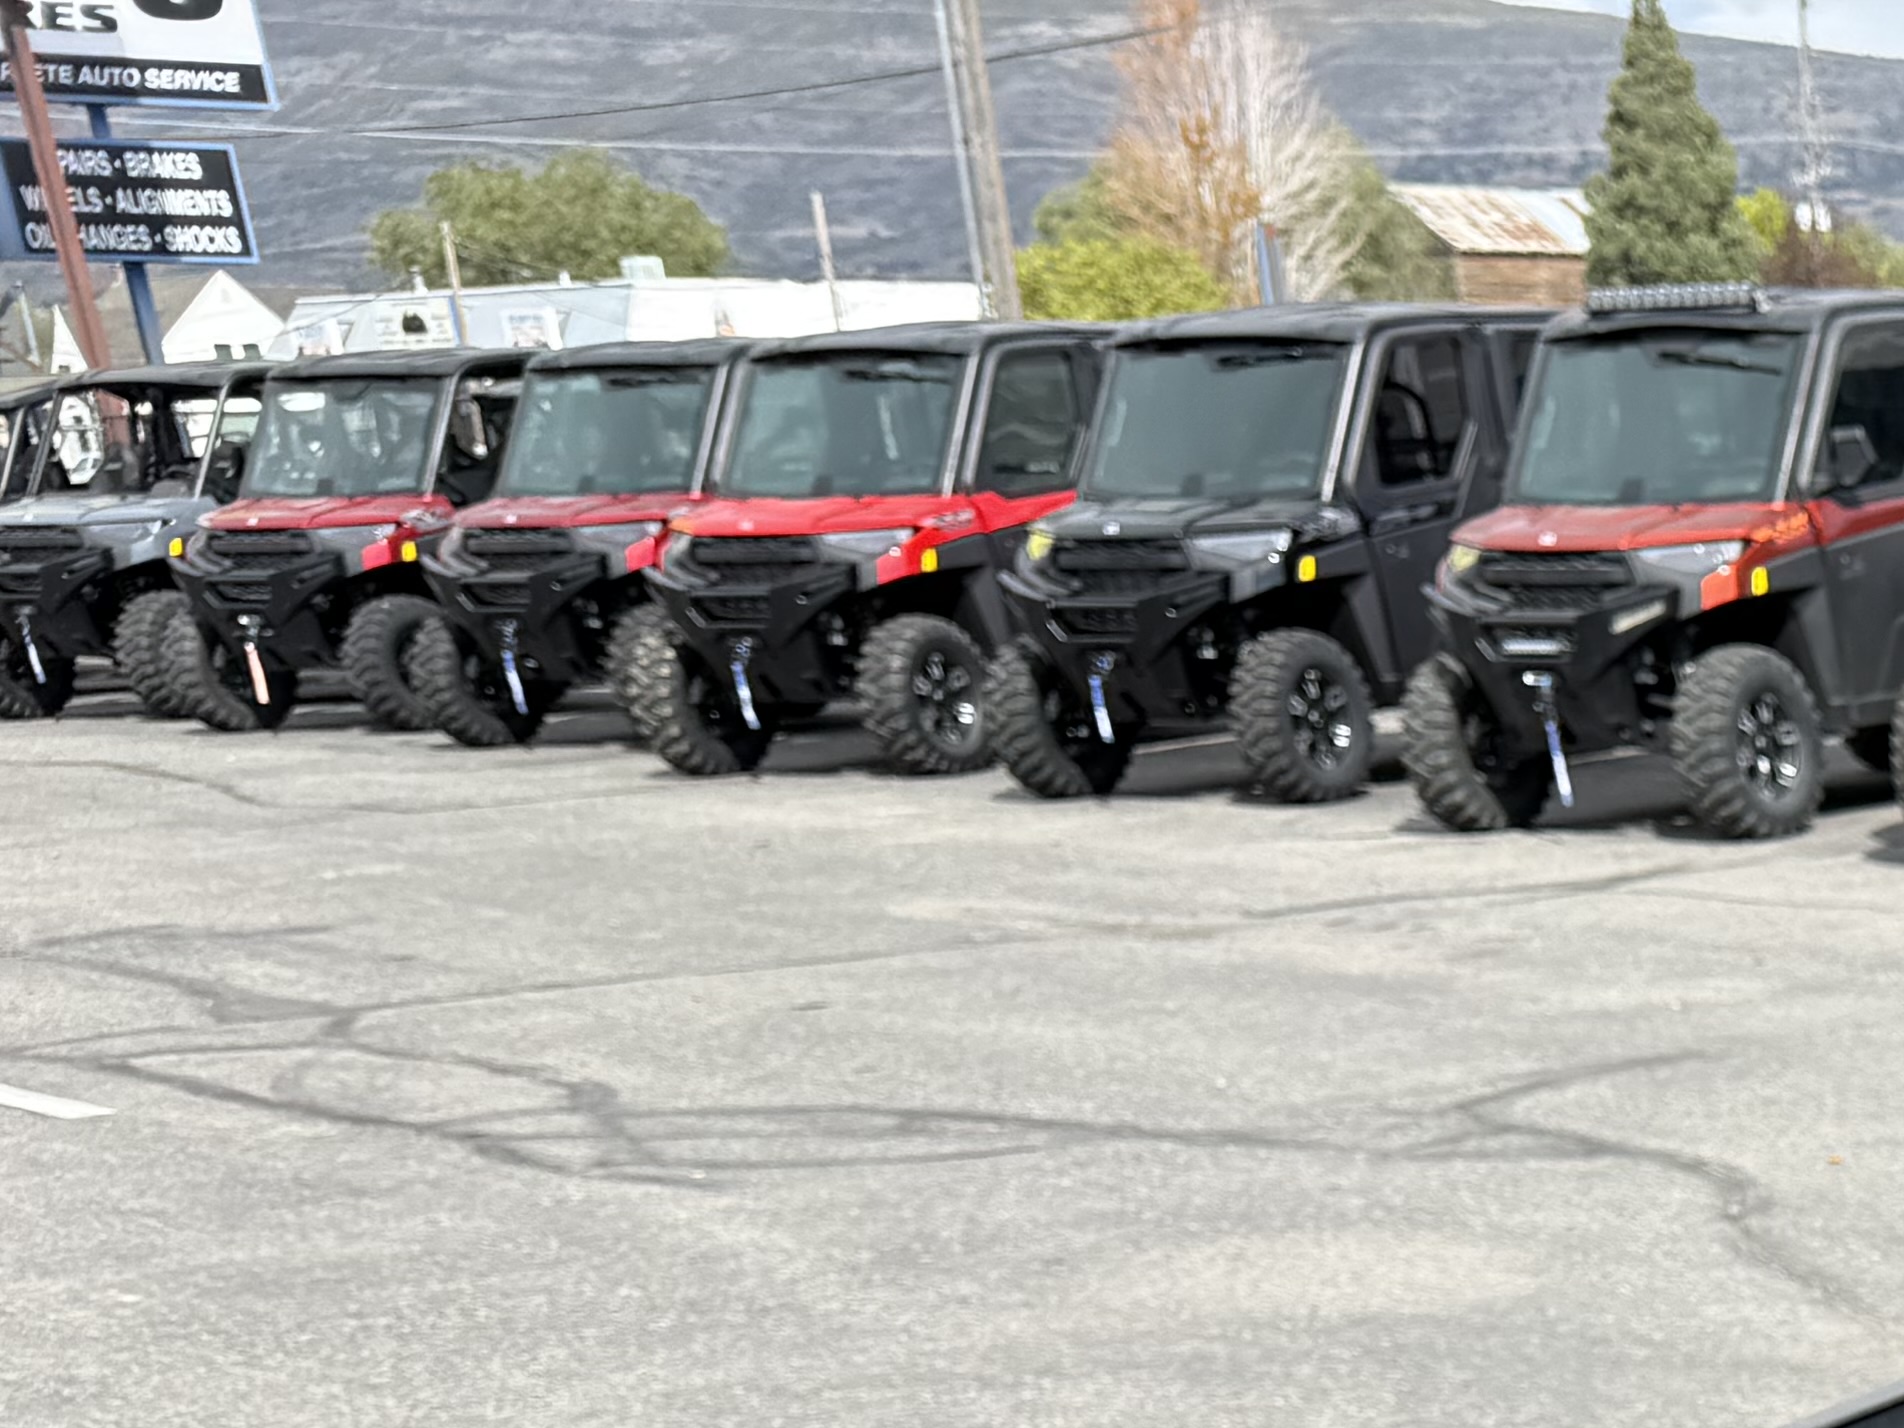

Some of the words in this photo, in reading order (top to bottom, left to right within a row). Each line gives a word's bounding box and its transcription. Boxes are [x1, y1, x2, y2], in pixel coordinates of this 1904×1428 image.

[78, 65, 142, 88] AUTO
[144, 69, 242, 94] SERVICE
[56, 149, 113, 176] PAIRS
[122, 151, 204, 180] BRAKES
[115, 187, 233, 217] ALIGNMENTS
[78, 223, 153, 251] HANGES
[163, 225, 243, 253] SHOCKS
